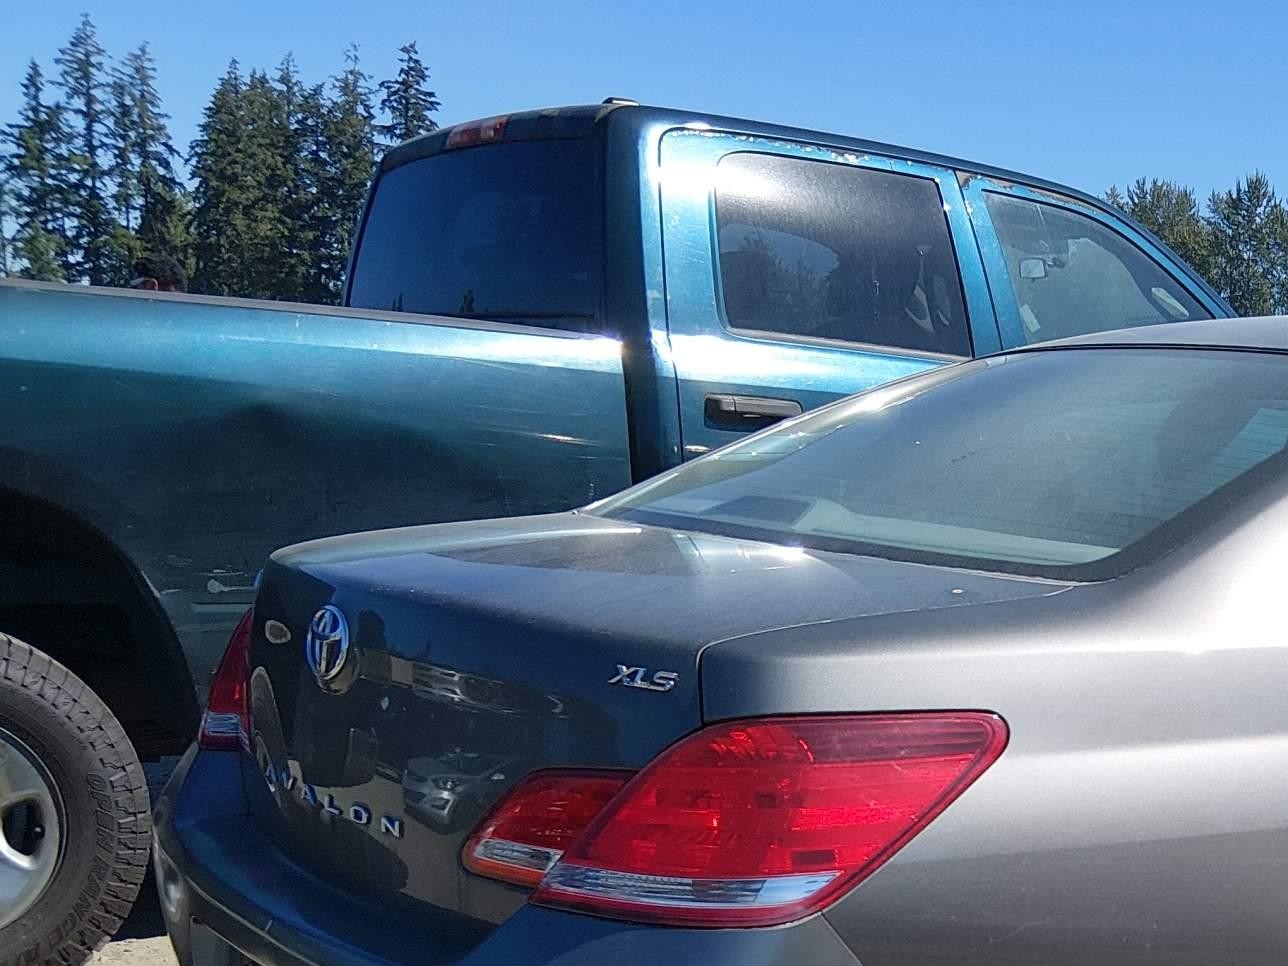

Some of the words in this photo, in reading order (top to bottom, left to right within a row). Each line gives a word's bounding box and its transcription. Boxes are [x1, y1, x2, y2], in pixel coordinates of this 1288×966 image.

[607, 664, 679, 692] XLS
[85, 772, 116, 854] OPEN
[264, 763, 403, 839] AVALON
